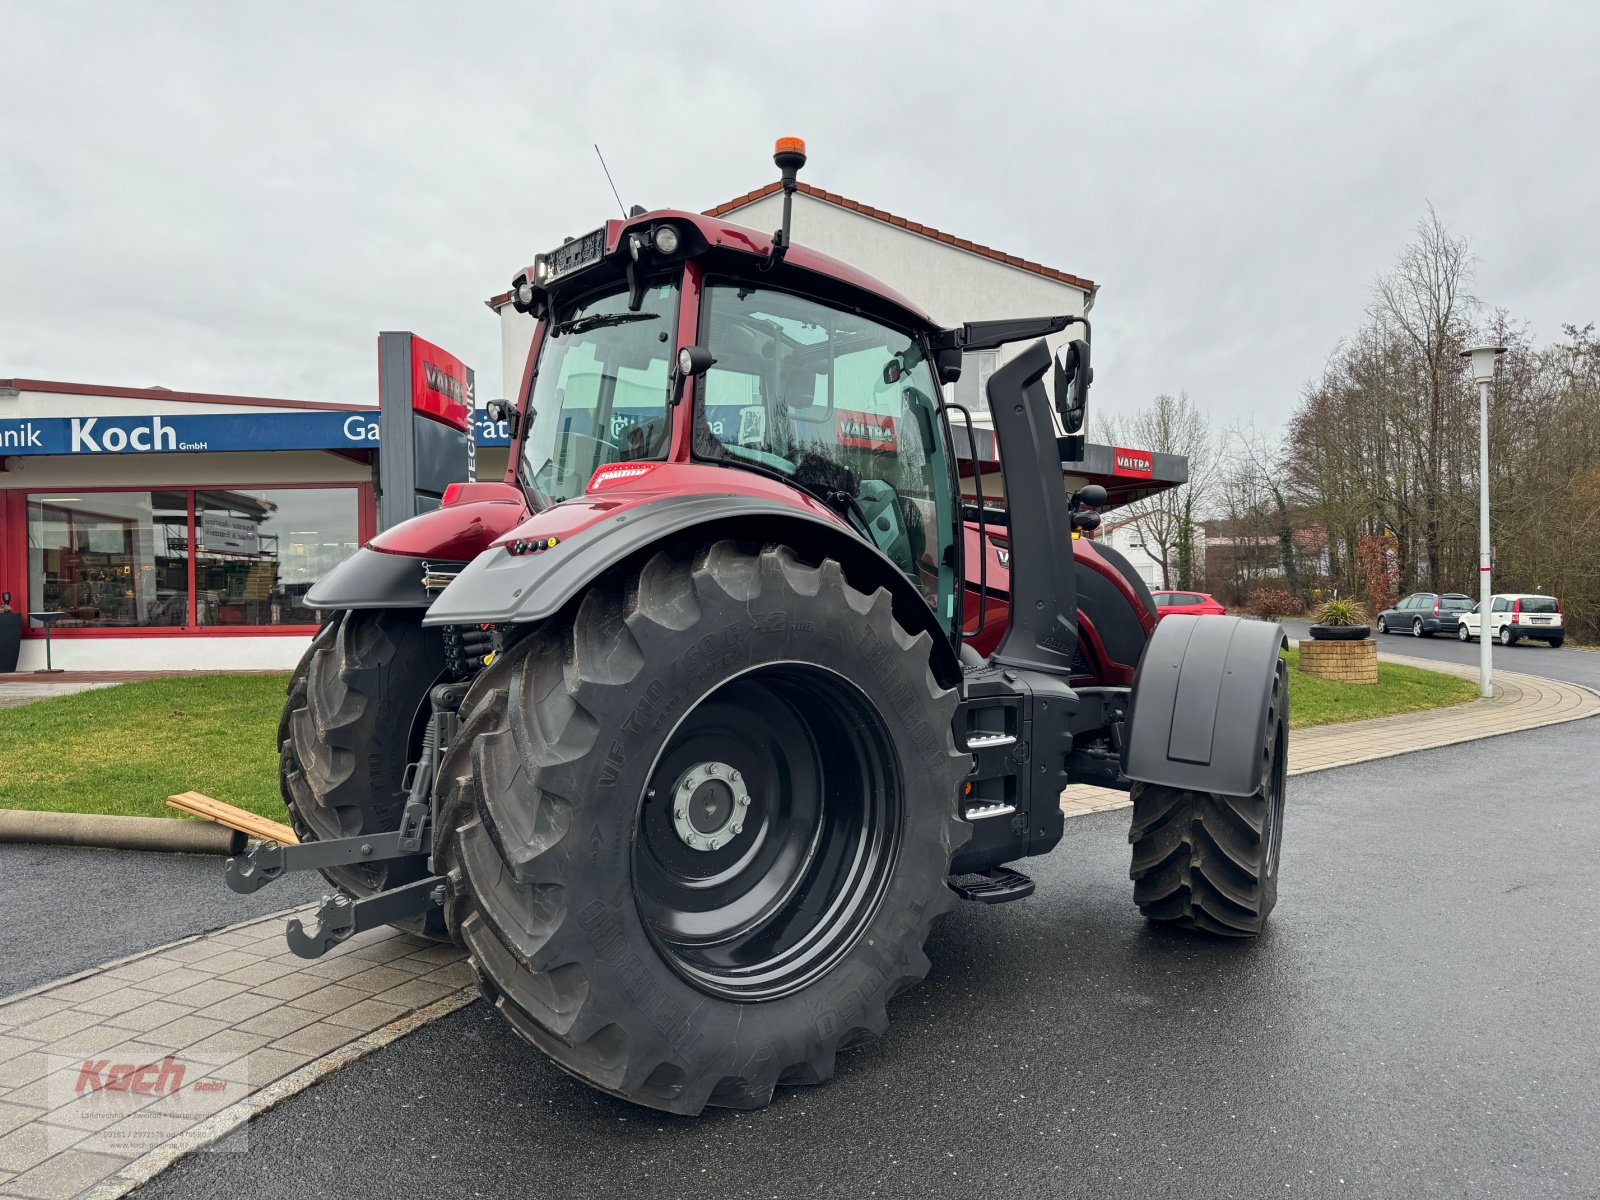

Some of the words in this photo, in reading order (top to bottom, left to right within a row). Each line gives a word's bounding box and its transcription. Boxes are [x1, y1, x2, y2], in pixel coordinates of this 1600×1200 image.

[422, 360, 464, 405] VALTRA
[0, 422, 43, 448] nik
[70, 416, 177, 452] Koch
[178, 442, 208, 450] GmbH
[839, 416, 894, 442] VALTRA
[1117, 454, 1151, 472] VALTRA
